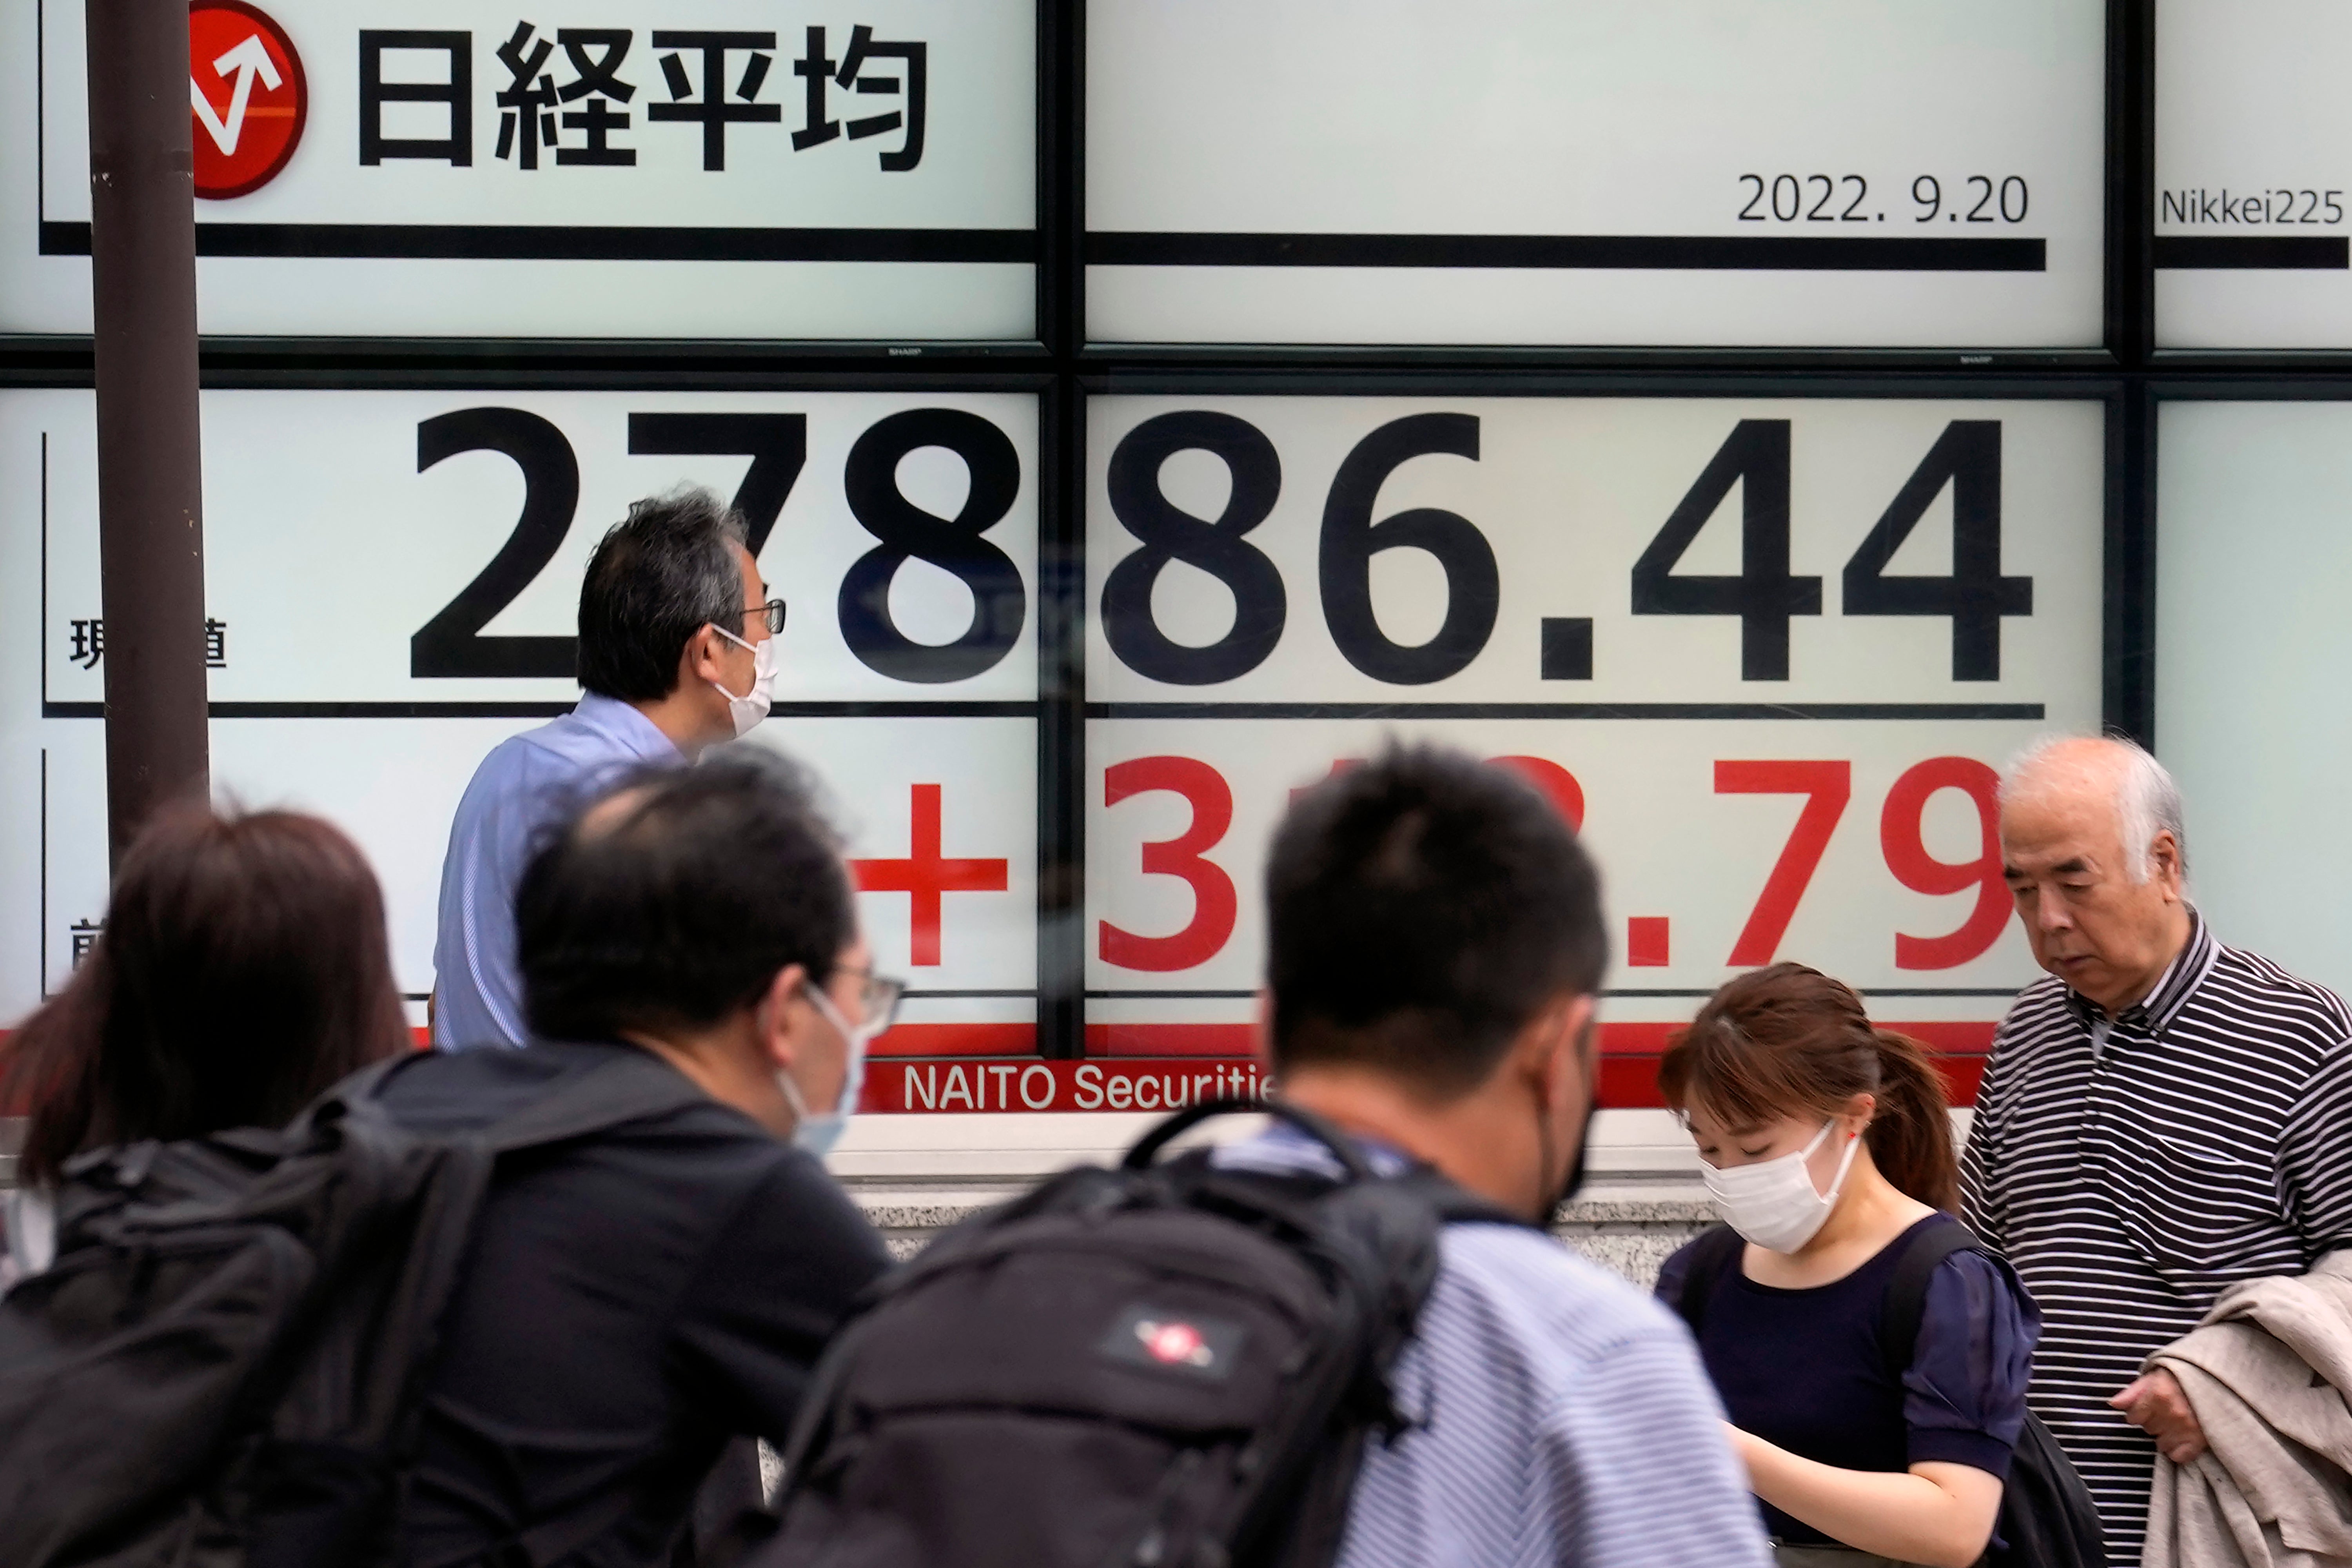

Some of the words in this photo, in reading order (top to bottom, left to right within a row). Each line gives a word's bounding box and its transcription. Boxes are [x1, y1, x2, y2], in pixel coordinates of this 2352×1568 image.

[359, 20, 927, 172] 日経平均
[1738, 174, 1885, 222] 2022.
[1912, 175, 2029, 223] 9.20
[2162, 189, 2343, 224] Nikkei225
[410, 407, 2033, 686] 27886.44
[847, 755, 2014, 972] +3.79
[904, 1065, 1056, 1110] NAITO
[1074, 1064, 1277, 1109] Securitie
